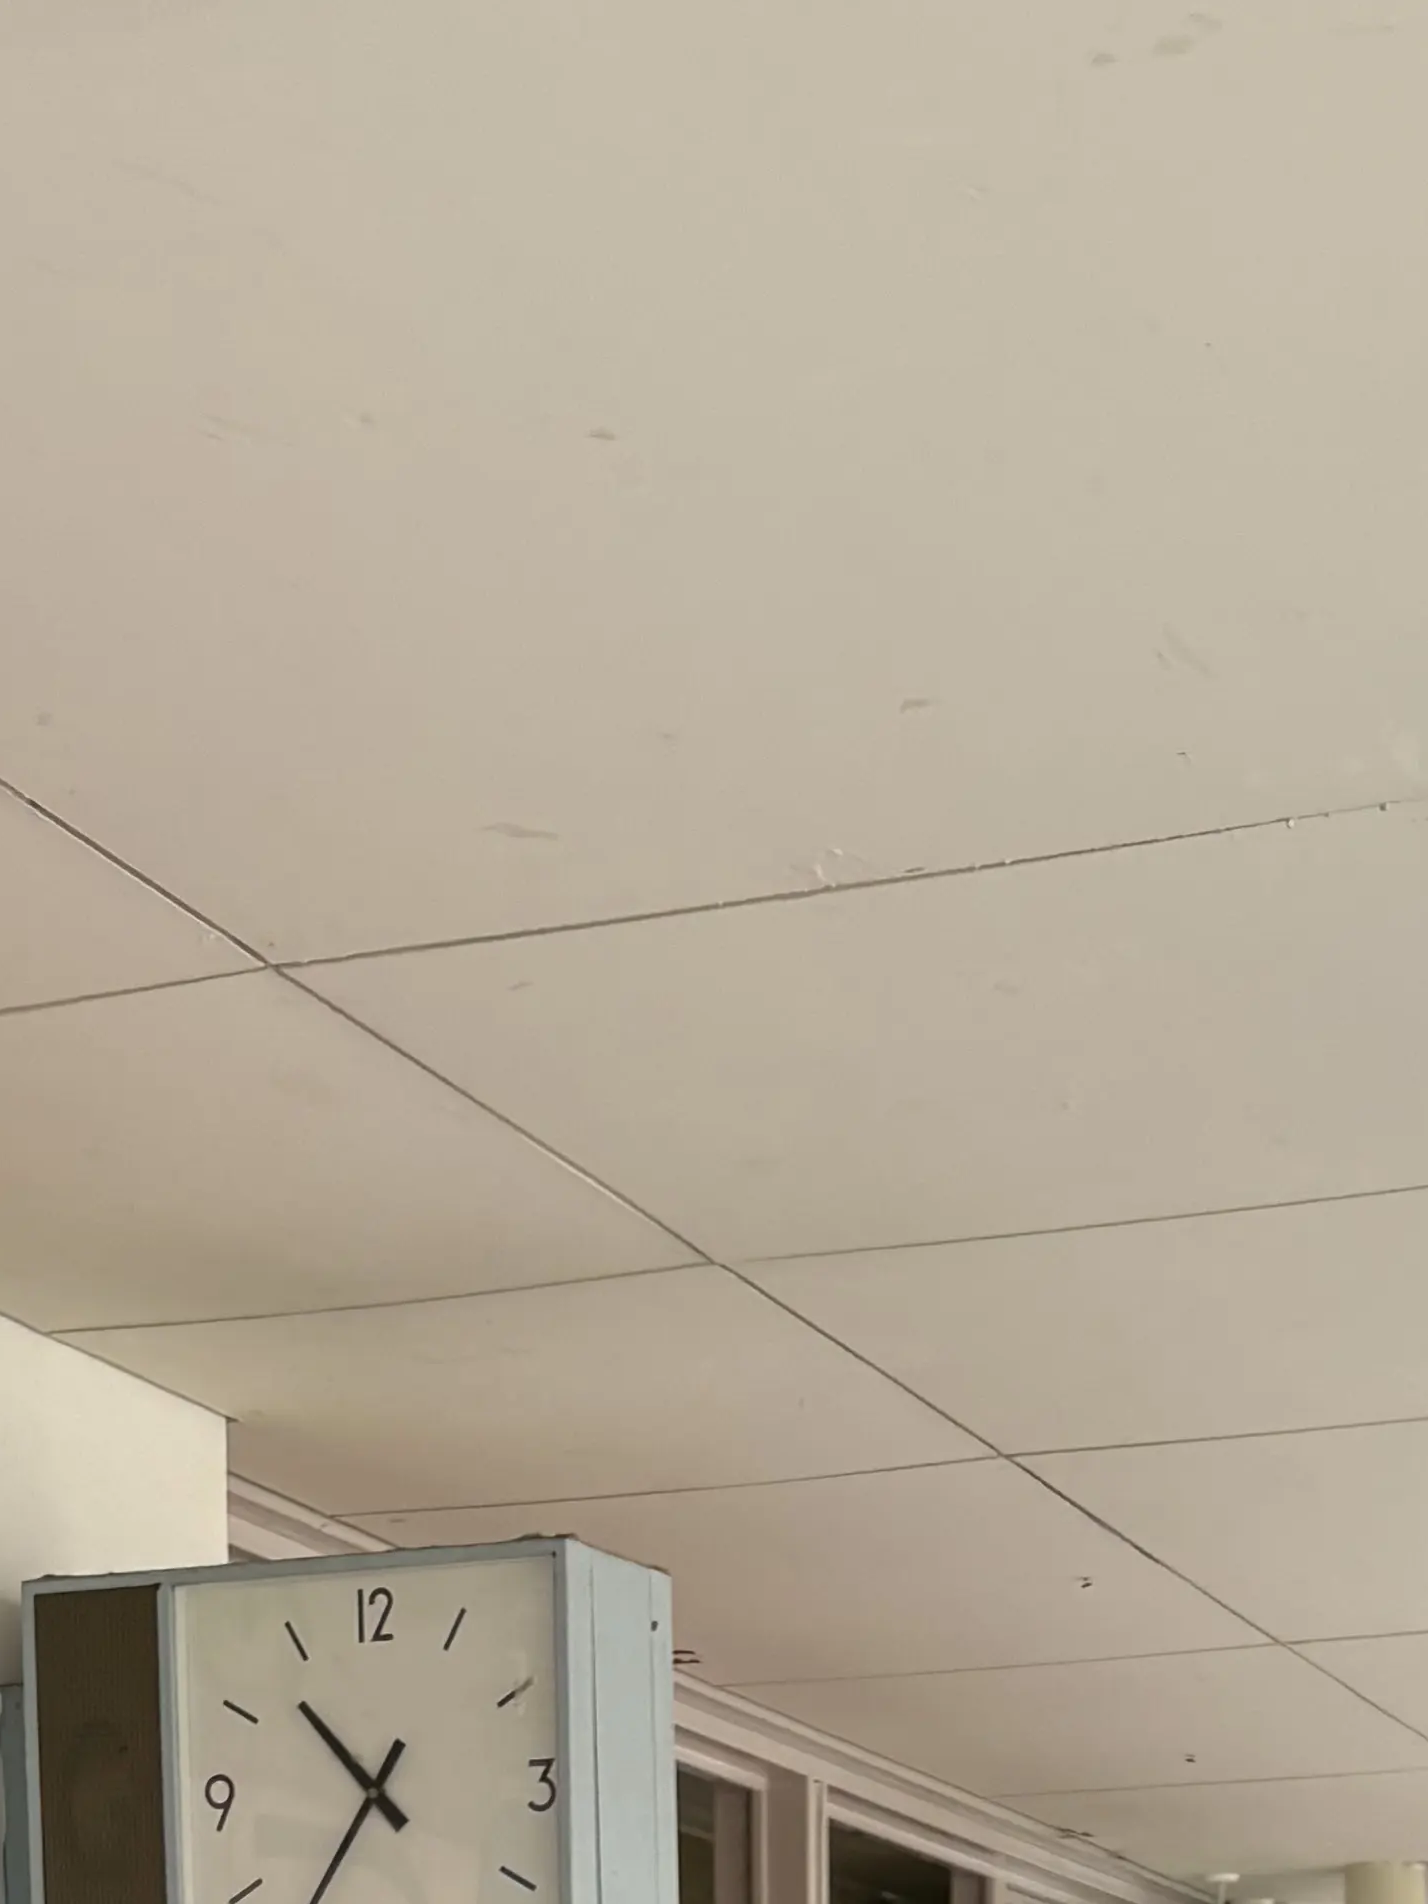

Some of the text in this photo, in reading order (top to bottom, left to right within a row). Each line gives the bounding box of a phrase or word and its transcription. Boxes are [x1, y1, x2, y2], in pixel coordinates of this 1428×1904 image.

[356, 1587, 395, 1644] 12
[204, 1773, 236, 1832] 9
[527, 1758, 558, 1812] 3
